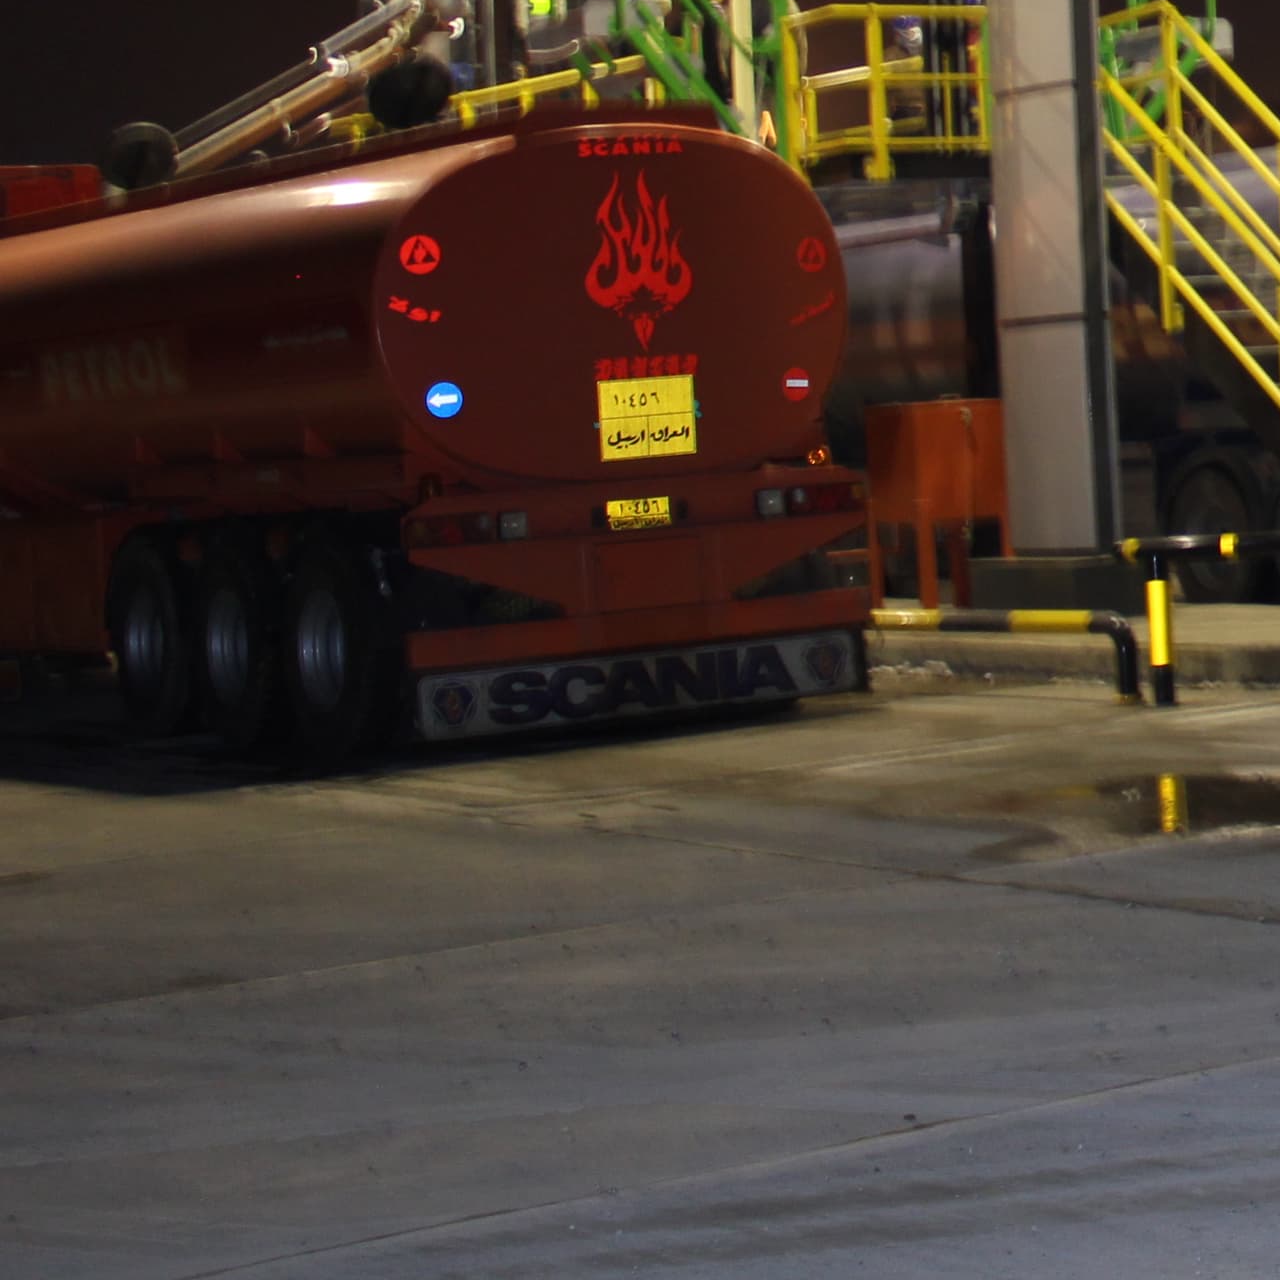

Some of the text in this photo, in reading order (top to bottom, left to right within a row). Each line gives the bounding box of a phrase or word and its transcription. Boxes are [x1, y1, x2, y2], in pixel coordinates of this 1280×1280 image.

[577, 134, 682, 157] SCANIA
[613, 391, 660, 408] ١٠٤٥٦
[650, 425, 690, 442] العراق
[619, 500, 660, 515] ١٠٤٥٦
[488, 644, 798, 724] SCANIA
